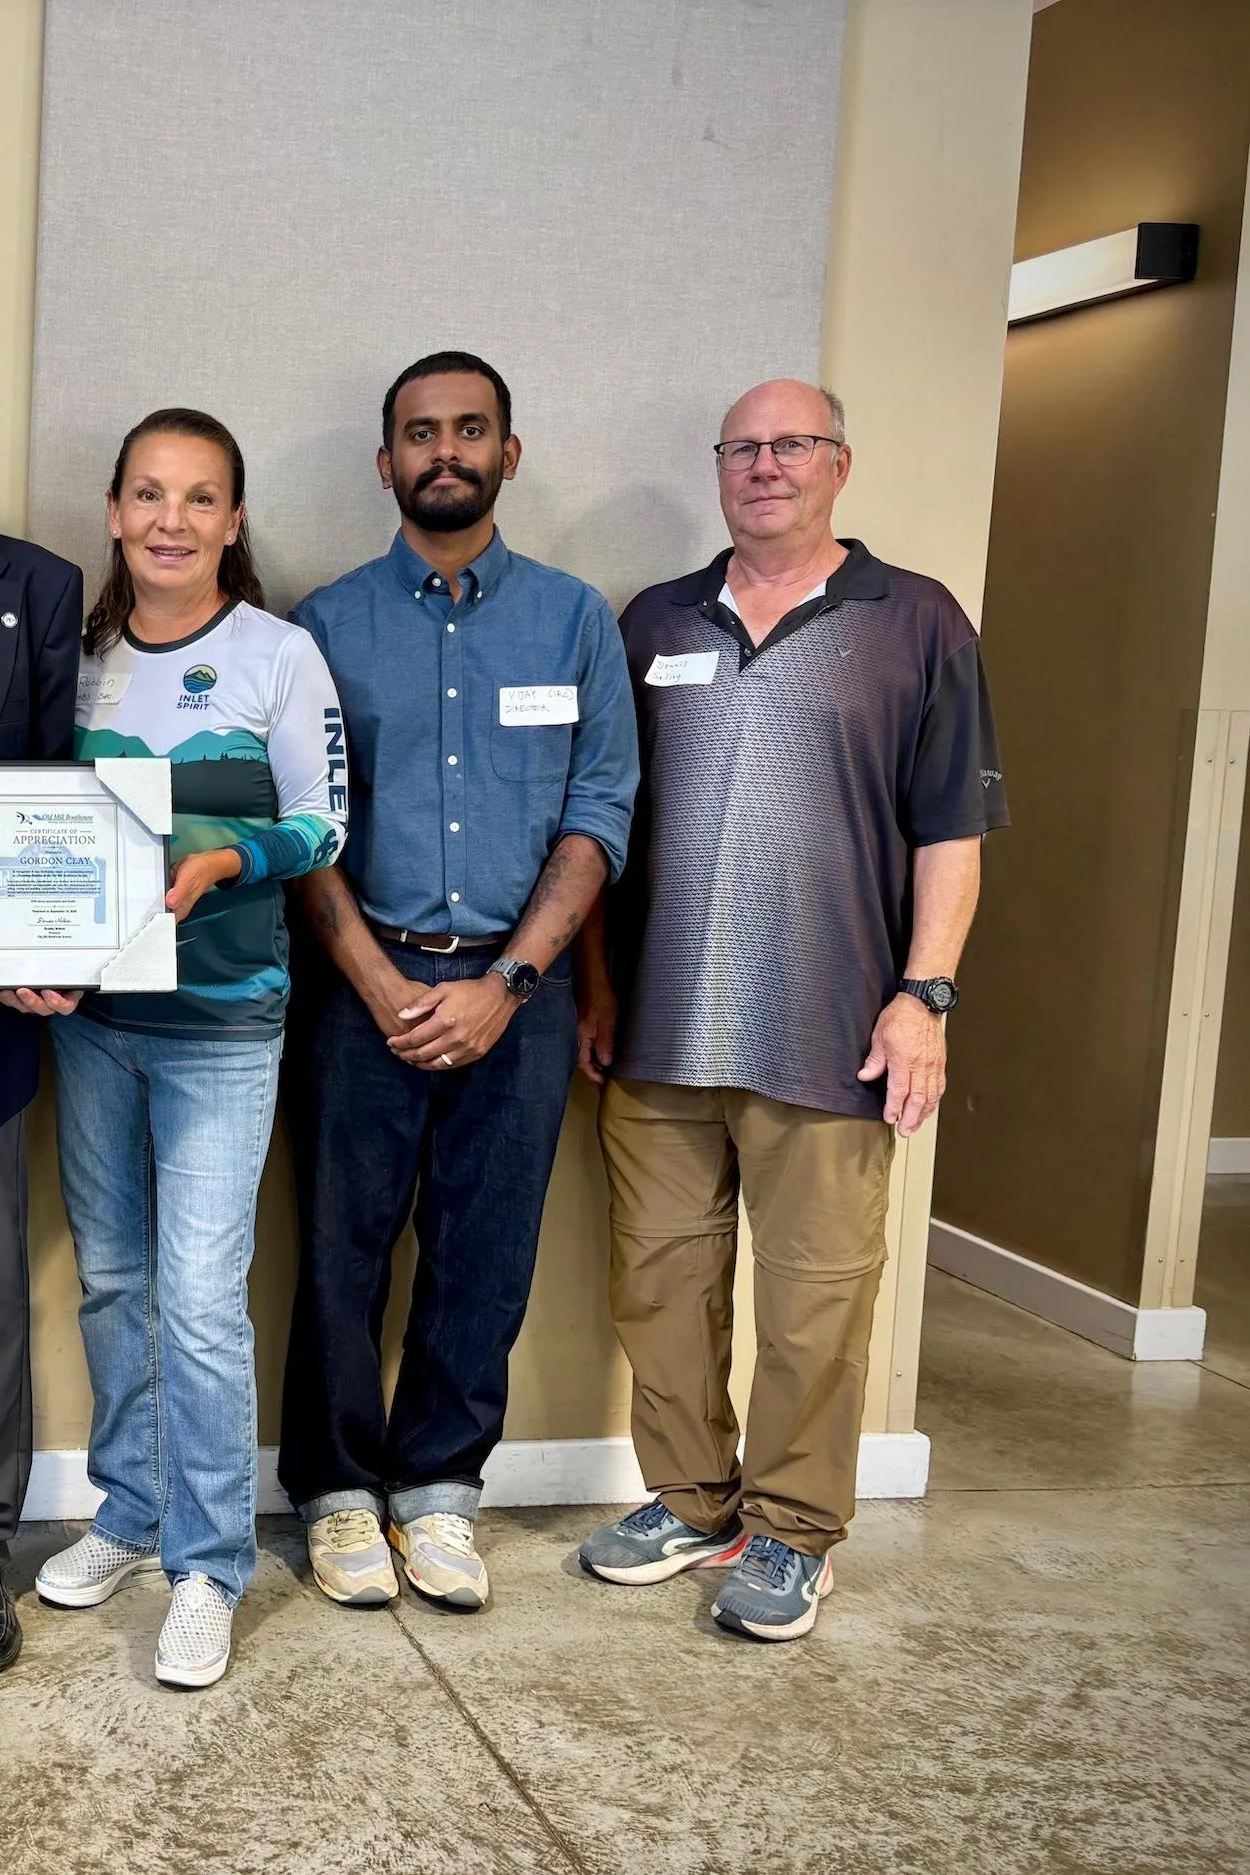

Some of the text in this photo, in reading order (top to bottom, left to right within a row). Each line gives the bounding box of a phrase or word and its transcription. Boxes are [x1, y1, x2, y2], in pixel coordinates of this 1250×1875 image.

[178, 694, 211, 703] INLET
[176, 702, 211, 711] SPIRIT
[324, 708, 347, 812] INLE
[13, 835, 95, 845] APPRECIATION
[20, 856, 90, 865] GORDON CLAY
